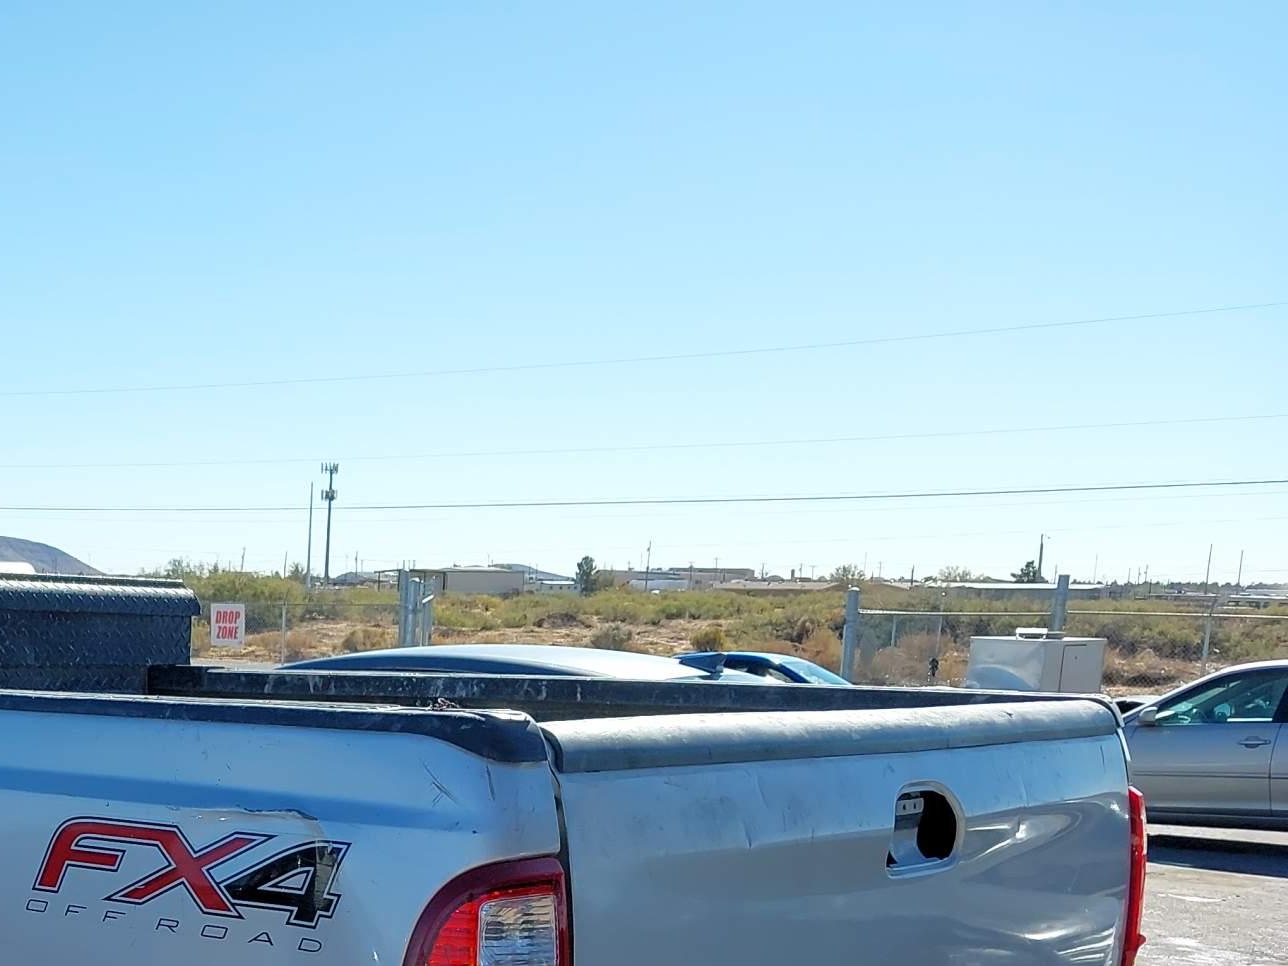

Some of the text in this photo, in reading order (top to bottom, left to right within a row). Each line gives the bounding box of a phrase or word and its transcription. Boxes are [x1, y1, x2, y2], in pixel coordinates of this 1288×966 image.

[215, 610, 241, 625] DROP
[216, 626, 239, 640] ZONE
[32, 815, 353, 929] FX4
